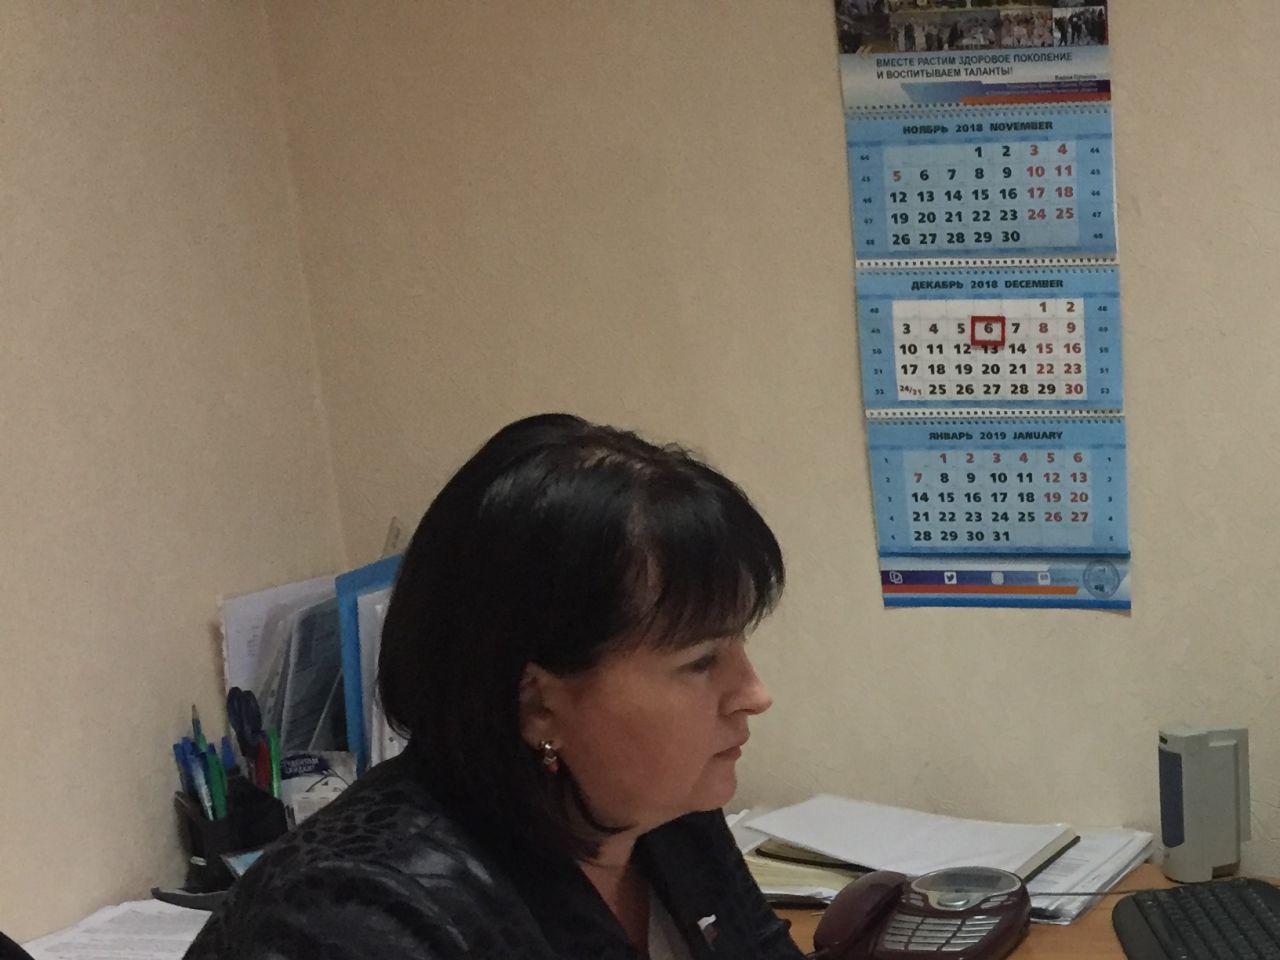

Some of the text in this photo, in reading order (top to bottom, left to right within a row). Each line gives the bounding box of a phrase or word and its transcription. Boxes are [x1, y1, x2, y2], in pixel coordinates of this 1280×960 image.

[875, 52, 1073, 68] ВМЕСТЕ РАСТИМ ЗДОРОВОЕ ПОКОЛЕНИЕ
[876, 66, 1013, 80] И ВОСПИТЫВАЕМ ТАЛАНТЫ!
[902, 121, 1053, 135] НОЯБРЬ 2018 NOVEMBER
[974, 146, 983, 158] 1
[1002, 145, 1011, 157] 2
[1030, 144, 1039, 157] 3
[1057, 143, 1068, 155] 4
[892, 170, 902, 182] 5
[919, 169, 930, 181] 6
[947, 168, 957, 181] 7
[974, 167, 985, 180] 8
[1002, 166, 1012, 179] 9
[1026, 165, 1046, 178] 10
[1054, 164, 1072, 177] 11
[889, 191, 908, 204] 12
[916, 190, 935, 203] 13
[944, 189, 963, 202] 14
[971, 188, 990, 201] 15
[999, 187, 1018, 200] 16
[1027, 186, 1045, 199] 17
[1055, 186, 1074, 198] 18
[890, 212, 909, 225] 19
[918, 211, 937, 224] 20
[944, 210, 963, 223] 21
[972, 210, 991, 222] 22
[999, 209, 1018, 222] 23
[1027, 208, 1047, 221] 24
[1055, 207, 1074, 220] 25
[892, 233, 911, 246] 26
[919, 232, 937, 245] 27
[946, 231, 966, 244] 28
[973, 231, 993, 244] 29
[1001, 230, 1021, 243] 30
[910, 279, 1064, 291] ДЕКАБРЬ 2018 DECEMBER
[1039, 301, 1047, 313] 1
[1066, 301, 1075, 313] 2
[902, 323, 911, 335] 3
[928, 323, 939, 335] 4
[957, 322, 966, 335] 5
[983, 322, 993, 334] 6
[1011, 322, 1021, 334] 7
[1038, 322, 1049, 334] 8
[1066, 321, 1077, 334] 9
[899, 343, 918, 355] 10
[926, 343, 944, 355] 11
[953, 343, 973, 355] 12
[980, 343, 999, 355] 13
[1008, 343, 1027, 355] 14
[1036, 342, 1054, 354] 15
[1063, 342, 1082, 354] 16
[900, 363, 918, 375] 17
[927, 363, 946, 375] 18
[954, 363, 973, 375] 19
[981, 363, 1001, 375] 20
[1009, 363, 1027, 375] 21
[1036, 363, 1055, 375] 22
[1063, 362, 1082, 375] 23
[928, 383, 947, 395] 25
[955, 383, 975, 395] 26
[983, 383, 1001, 395] 27
[1010, 383, 1030, 395] 28
[1037, 383, 1056, 395] 29
[1064, 383, 1084, 395] 30
[928, 431, 1063, 441] ЯНВАРЬ 2019 JANUARY
[939, 452, 947, 464] 1
[966, 452, 975, 464] 2
[992, 452, 1001, 464] 3
[1019, 452, 1029, 464] 4
[1047, 452, 1055, 464] 5
[1072, 452, 1083, 463] 6
[913, 472, 923, 484] 7
[940, 472, 950, 484] 8
[966, 472, 976, 484] 9
[989, 472, 1008, 484] 10
[1016, 472, 1033, 483] 11
[1043, 471, 1060, 483] 12
[1070, 471, 1088, 483] 13
[911, 492, 930, 503] 14
[937, 492, 955, 503] 15
[964, 492, 982, 503] 16
[990, 492, 1008, 503] 17
[1017, 491, 1035, 503] 18
[1043, 491, 1062, 503] 19
[1070, 491, 1089, 503] 20
[912, 511, 930, 522] 21
[938, 511, 956, 522] 22
[965, 511, 983, 523] 23
[991, 511, 1010, 523] 24
[1017, 511, 1036, 523] 25
[1044, 511, 1063, 523] 26
[1071, 511, 1089, 523] 27
[914, 530, 932, 542] 28
[940, 530, 959, 542] 29
[966, 530, 985, 542] 30
[992, 530, 1010, 542] 31
